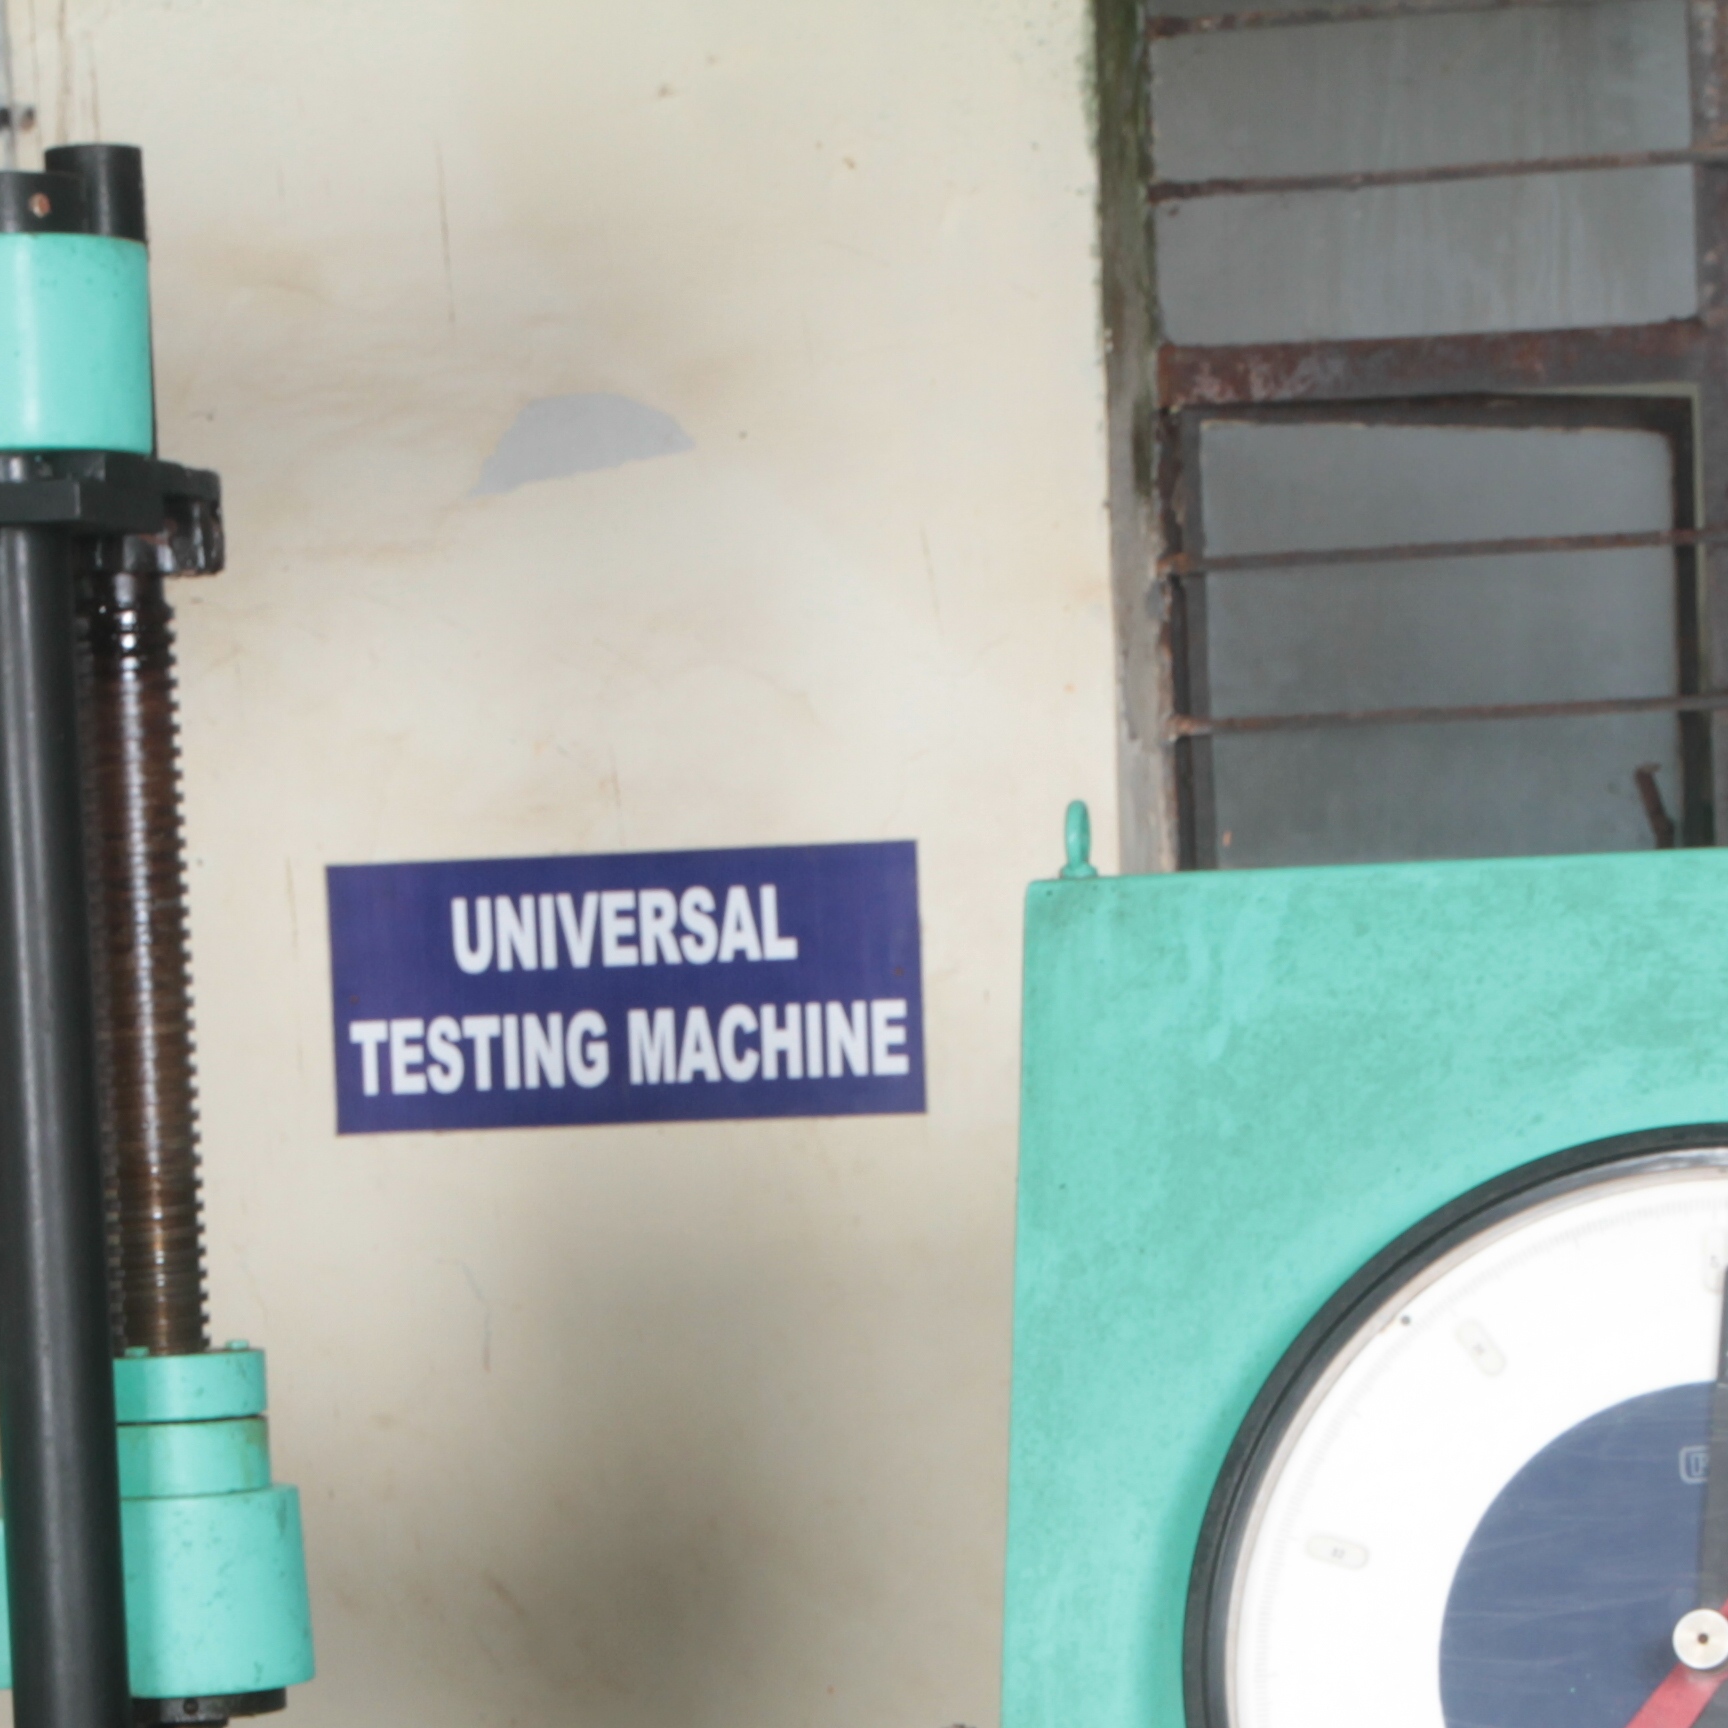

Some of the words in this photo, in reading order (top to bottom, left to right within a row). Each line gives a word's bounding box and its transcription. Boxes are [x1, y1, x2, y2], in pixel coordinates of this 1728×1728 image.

[450, 884, 798, 973] UNIVERSAL
[349, 1010, 609, 1096] TESTING
[627, 998, 910, 1085] MACHINE
